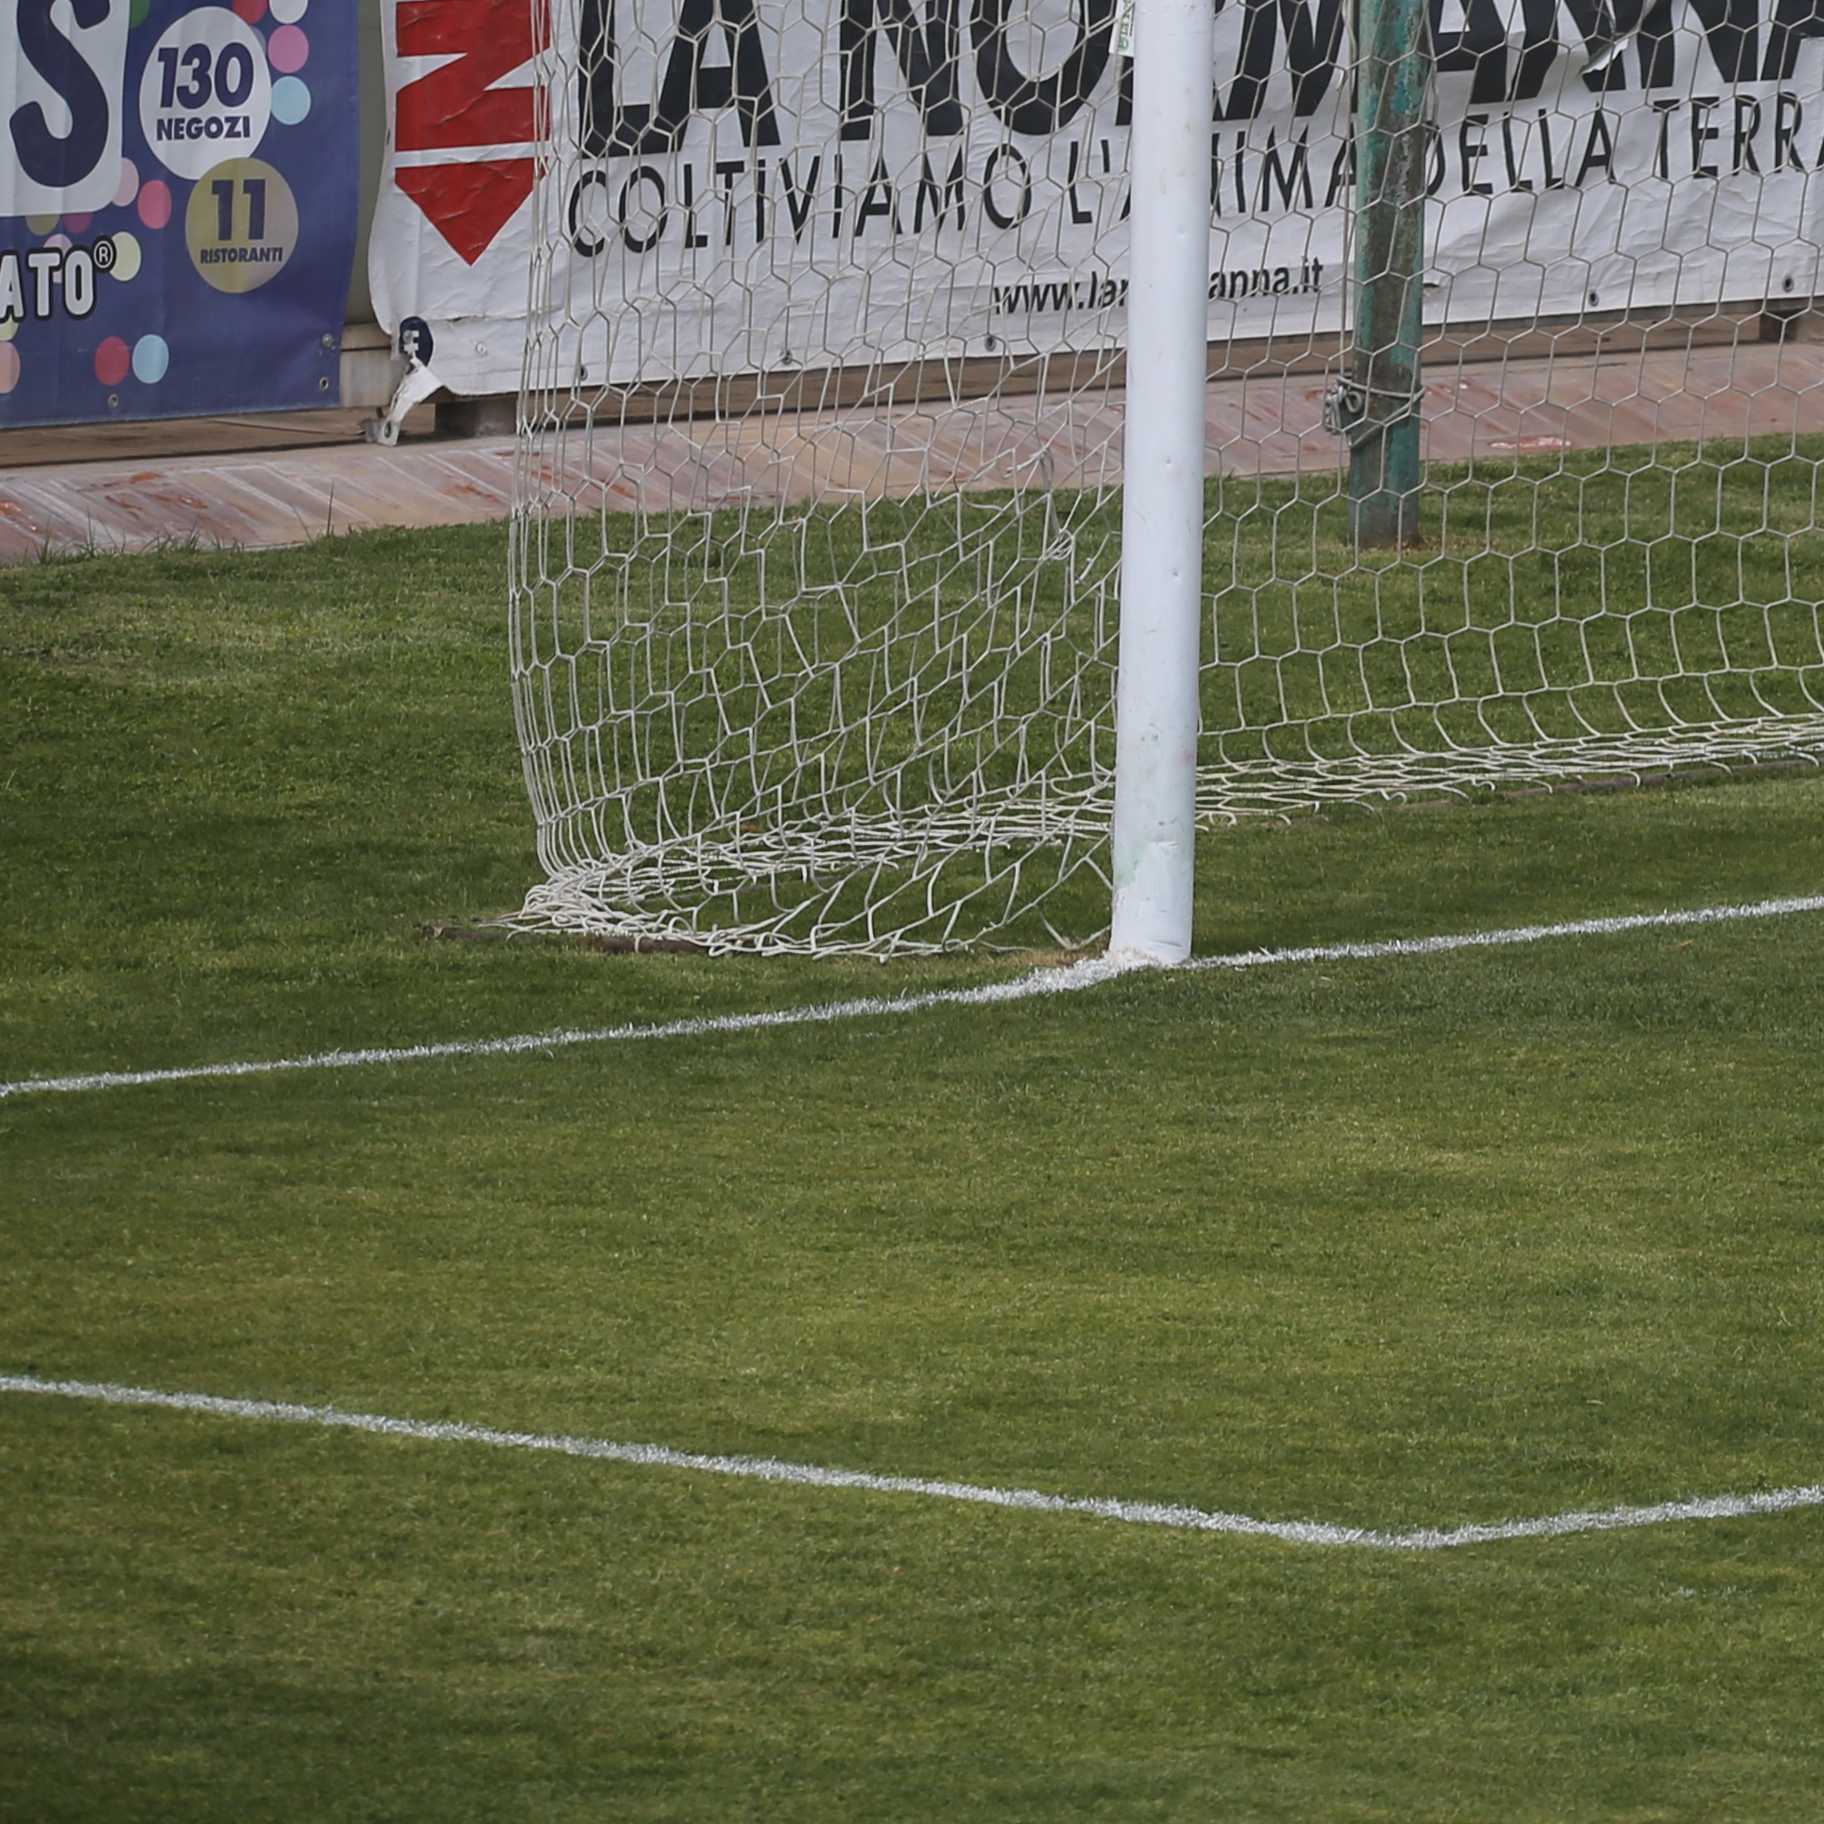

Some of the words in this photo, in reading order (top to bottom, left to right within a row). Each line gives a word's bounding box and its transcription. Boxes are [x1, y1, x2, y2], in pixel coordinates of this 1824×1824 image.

[156, 42, 255, 110] 130
[156, 116, 251, 142] NEGOZI
[211, 179, 266, 241] 11
[567, 142, 1032, 258] COLTIVIAMO
[200, 247, 283, 265] RISTORANTI
